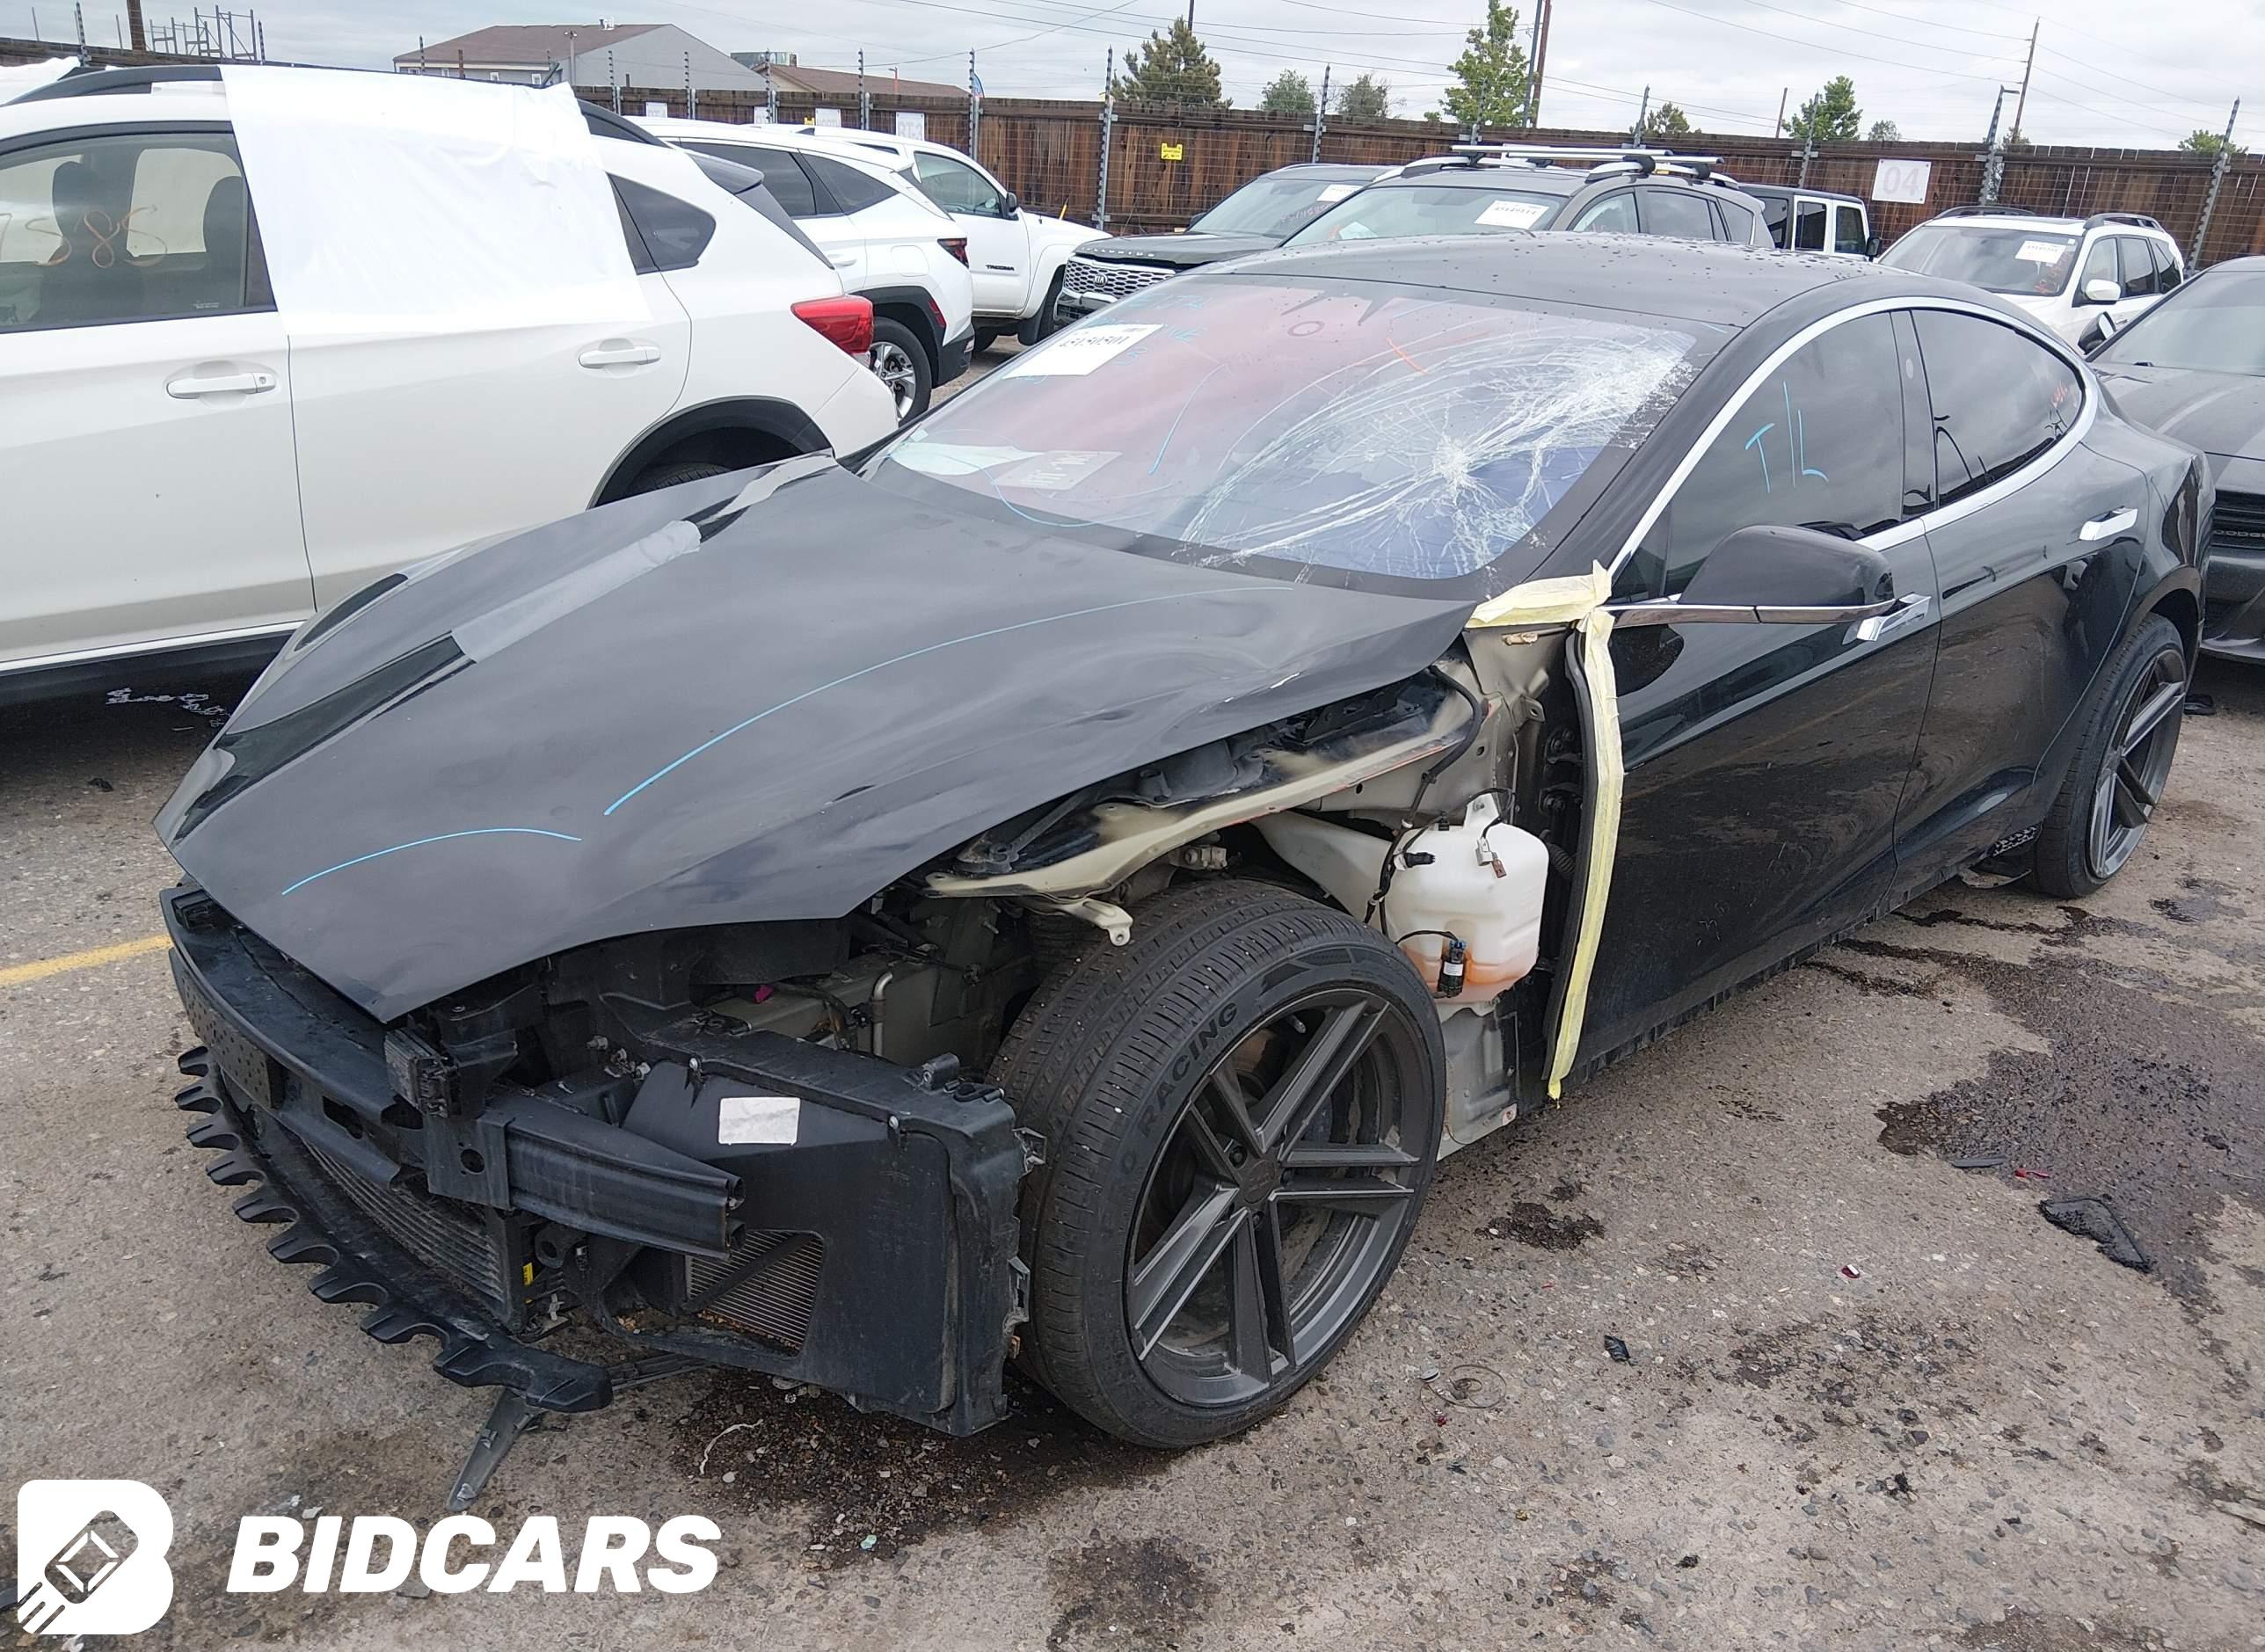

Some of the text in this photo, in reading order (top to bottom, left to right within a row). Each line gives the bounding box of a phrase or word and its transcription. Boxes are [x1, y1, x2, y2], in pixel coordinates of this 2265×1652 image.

[1883, 166, 1919, 197] 04
[1094, 274, 1106, 284] KIA
[1138, 1001, 1238, 1138] RACING
